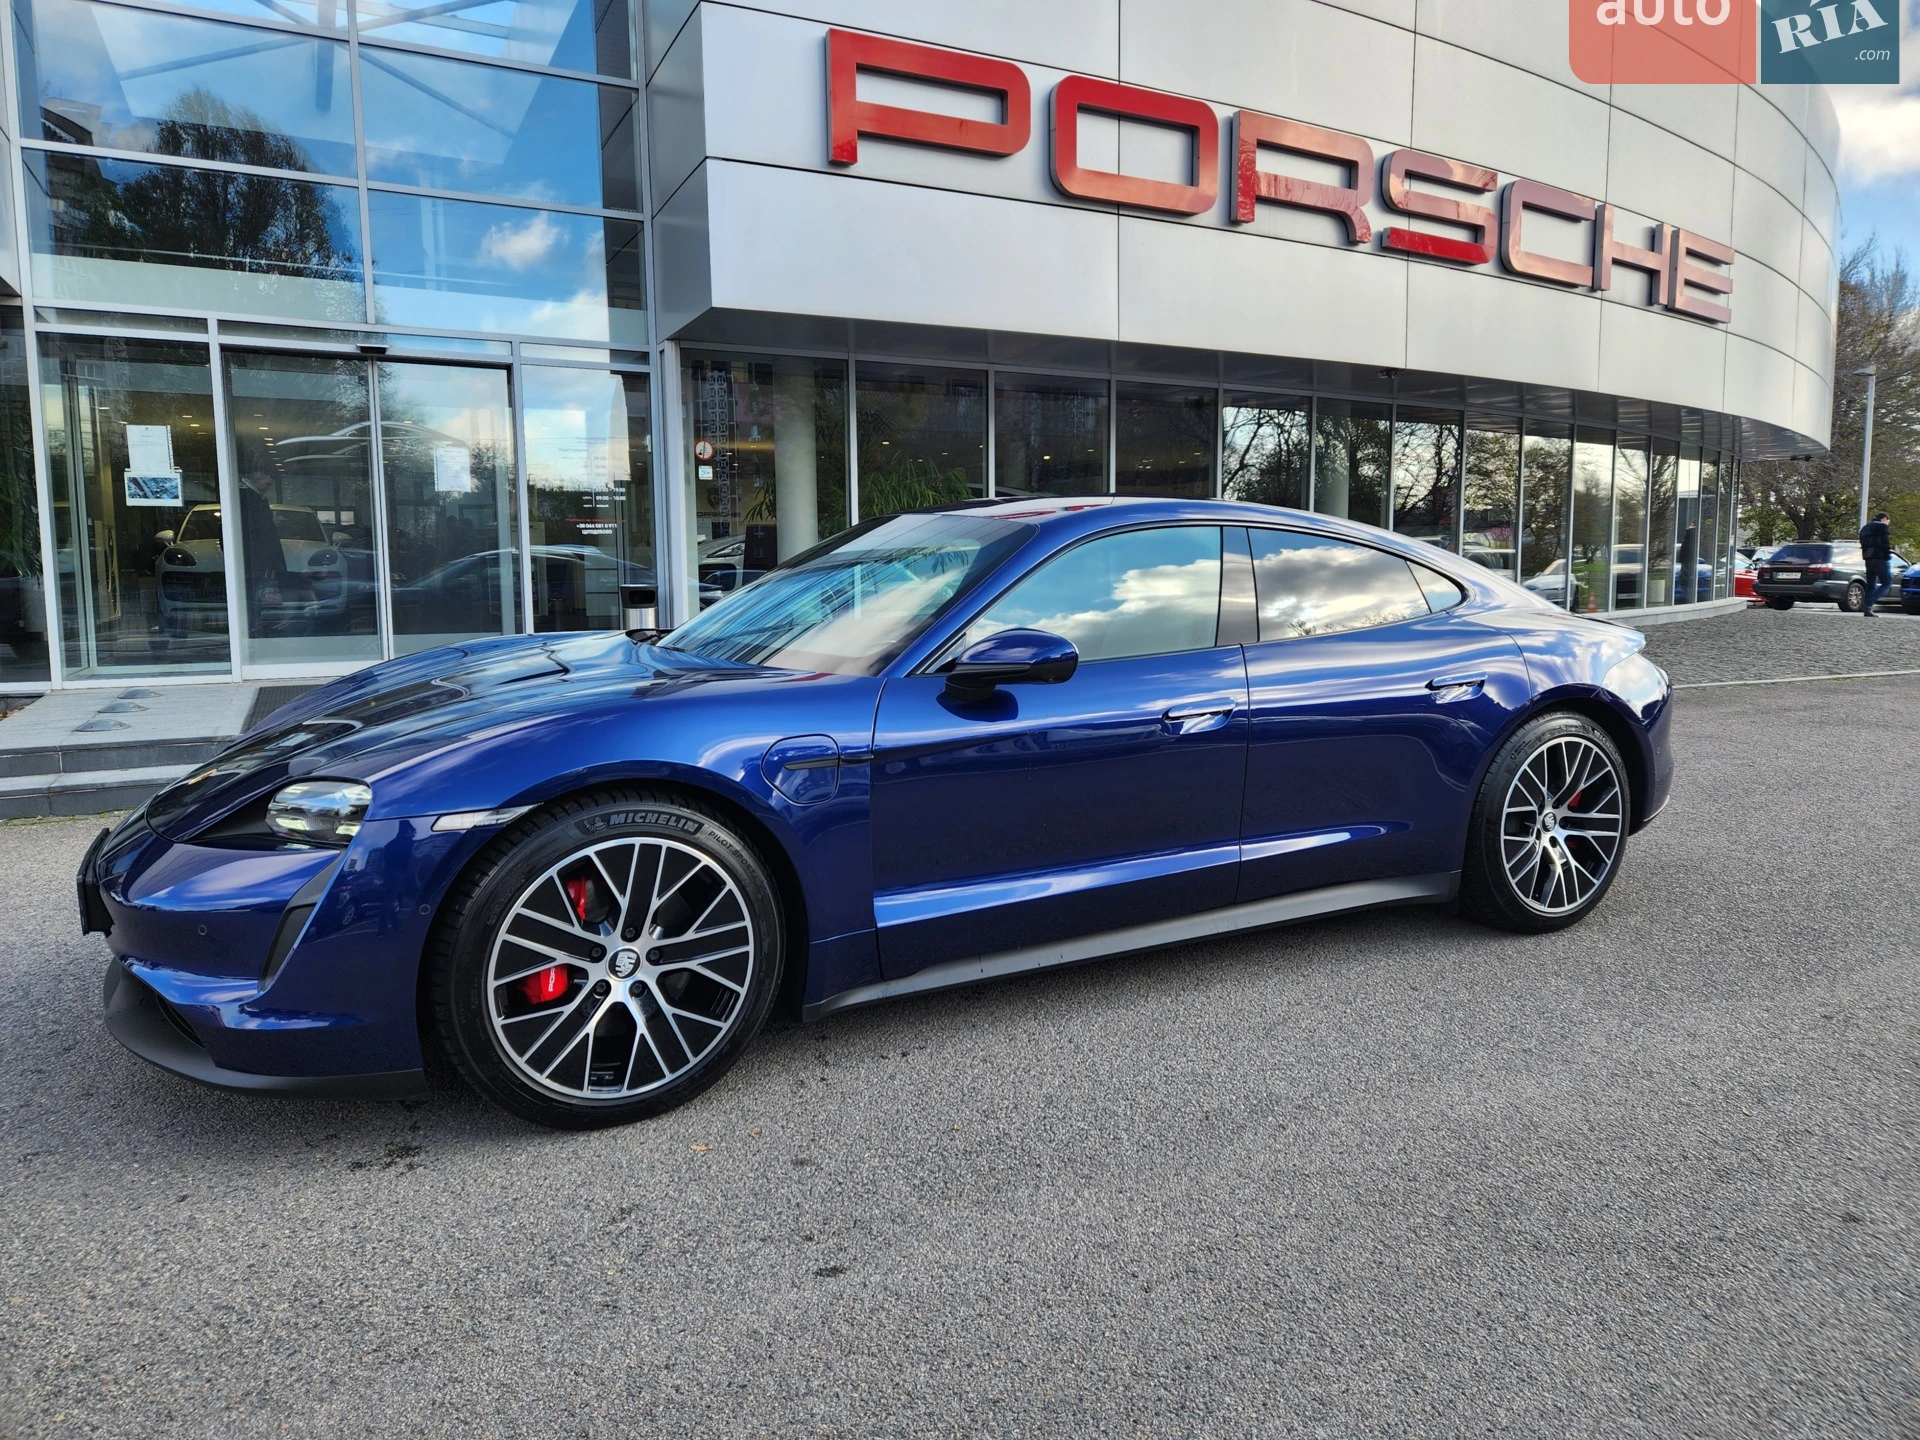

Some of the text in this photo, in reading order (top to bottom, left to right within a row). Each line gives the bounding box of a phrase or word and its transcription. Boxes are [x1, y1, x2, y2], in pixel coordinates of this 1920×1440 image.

[825, 28, 1735, 324] PORSCHE
[609, 812, 699, 832] MICHELIN
[707, 830, 757, 875] PILOT SPORT
